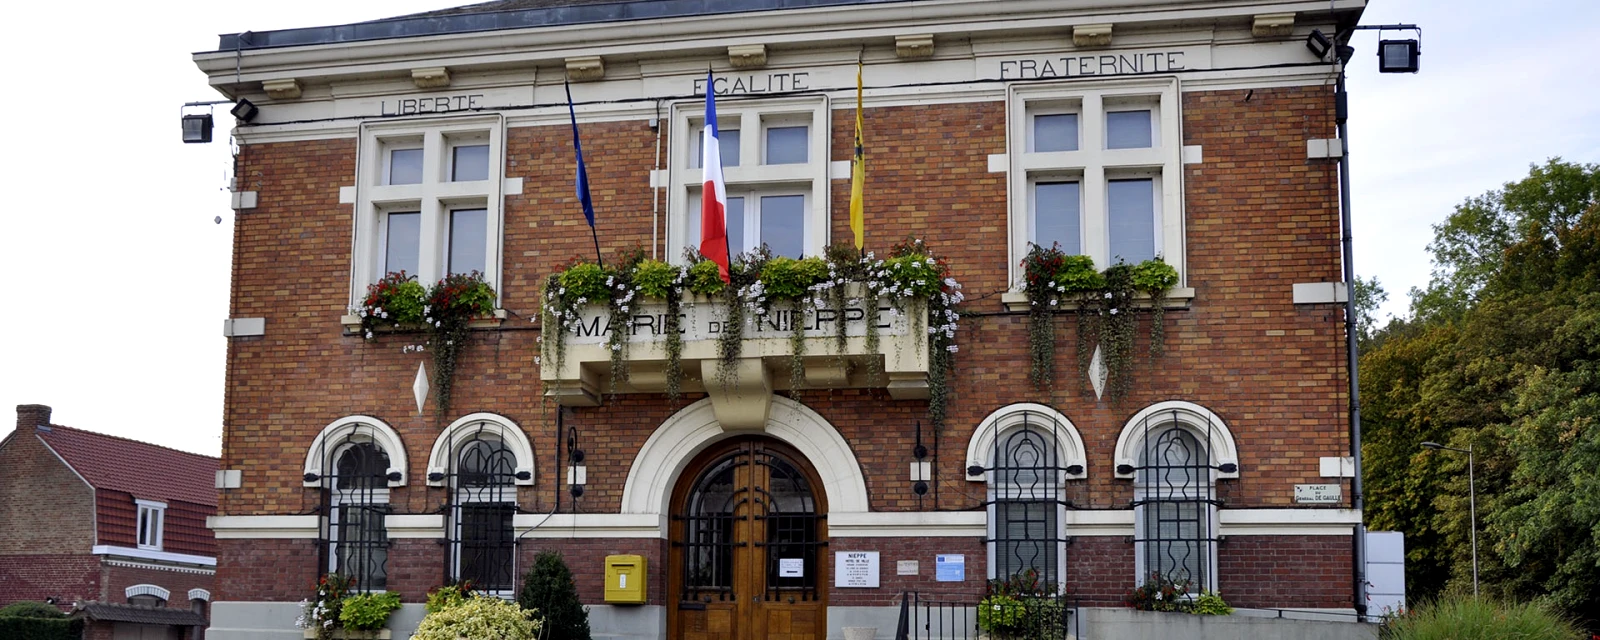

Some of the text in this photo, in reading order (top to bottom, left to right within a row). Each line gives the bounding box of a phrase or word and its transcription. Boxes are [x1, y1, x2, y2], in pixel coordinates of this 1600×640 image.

[1000, 51, 1185, 80] FRATERNITE
[693, 72, 809, 96] EGALITE
[380, 94, 484, 116] LIBERTE
[575, 313, 686, 337] MARIE
[757, 306, 891, 332] NIEPPE
